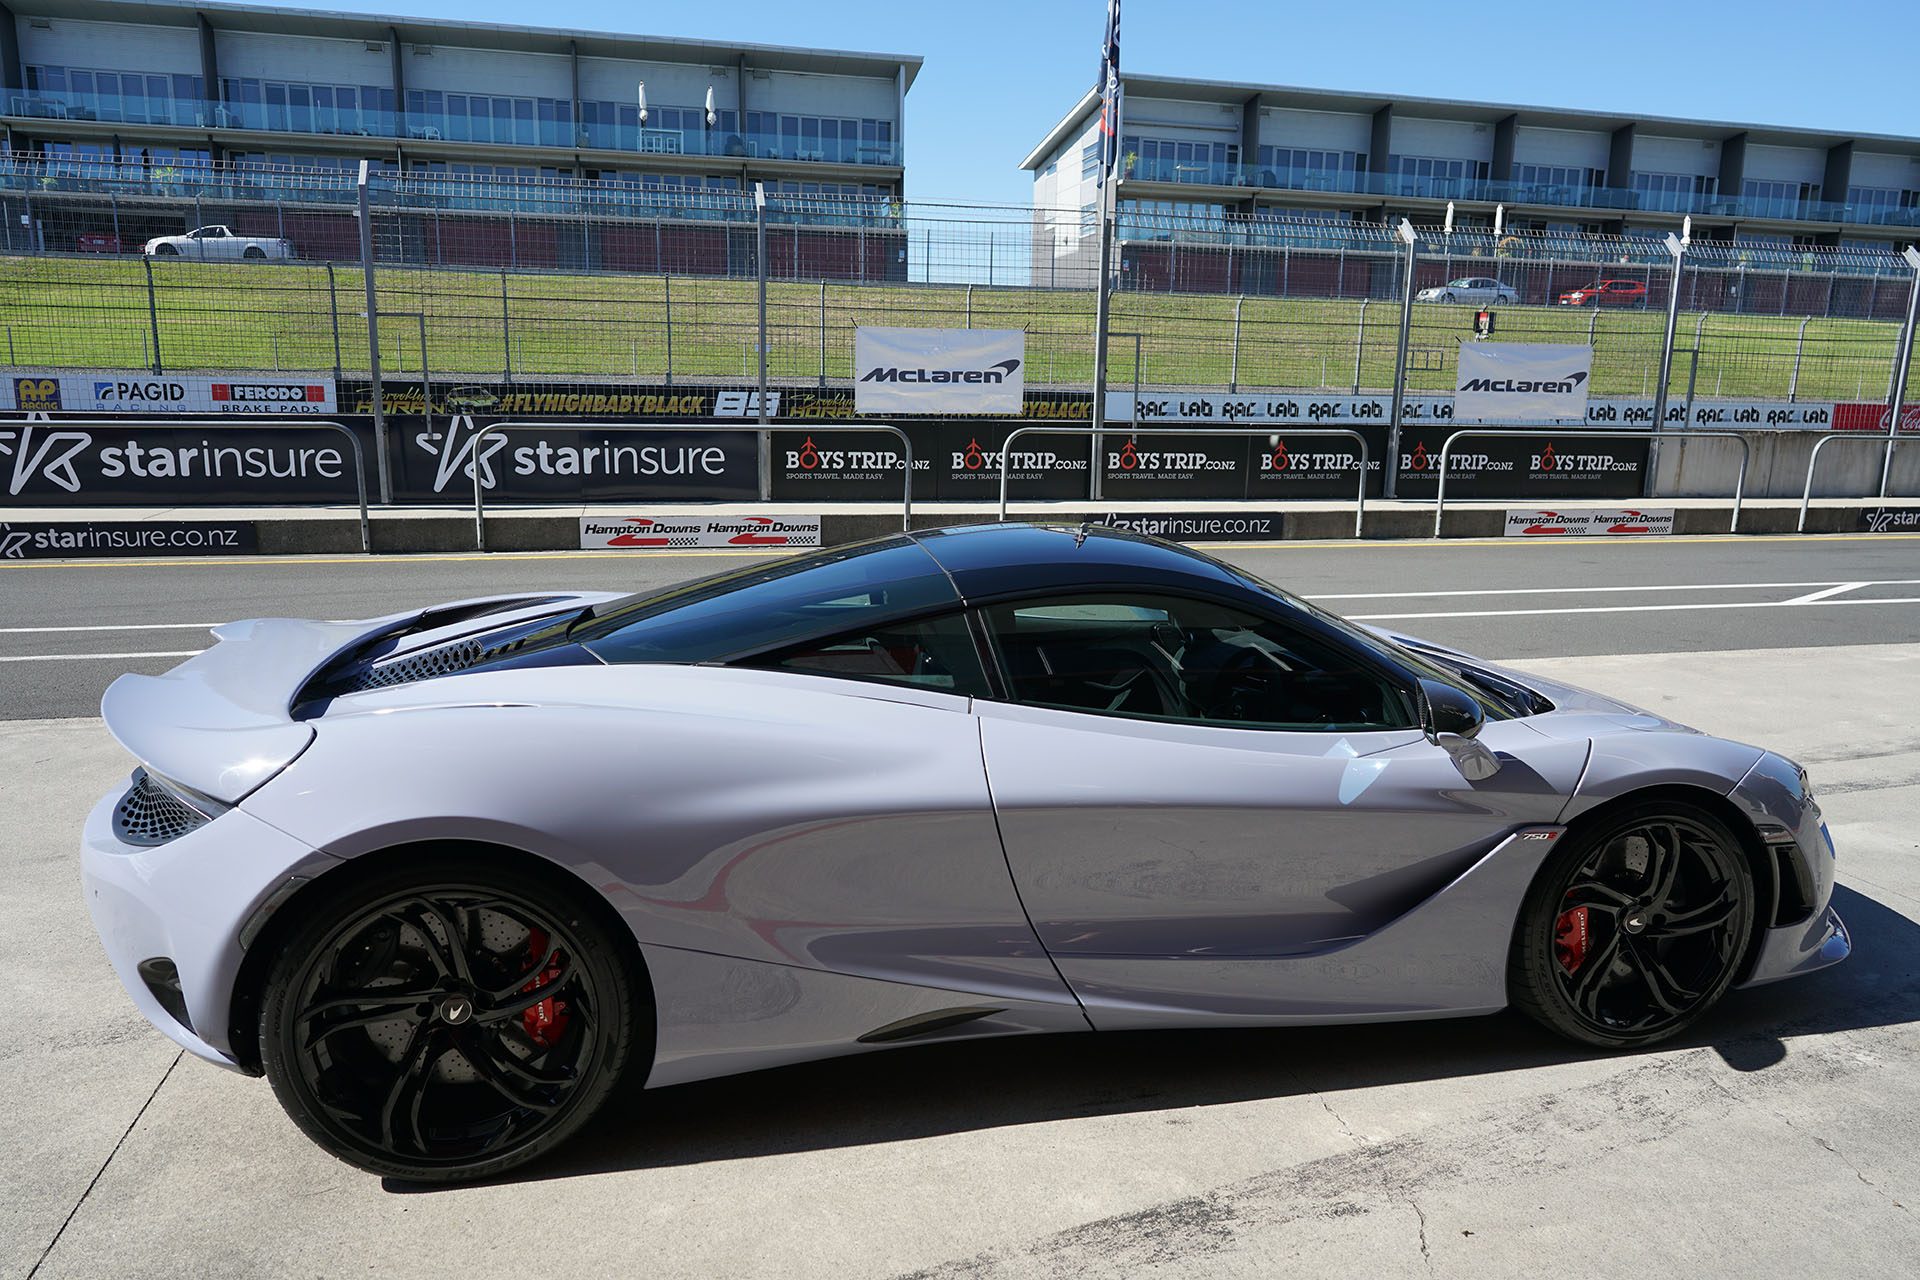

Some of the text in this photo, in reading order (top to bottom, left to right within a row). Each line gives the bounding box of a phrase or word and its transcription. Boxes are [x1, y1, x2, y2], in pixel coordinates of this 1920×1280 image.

[860, 367, 1003, 383] McLaren
[19, 380, 56, 400] AP
[118, 382, 185, 400] PAGID
[234, 386, 304, 400] FERODO
[1460, 378, 1573, 393] McLaren
[96, 403, 187, 411] RACING
[222, 405, 320, 414] BRAKE PADS
[501, 393, 705, 414] #FLYHIGHBABYBLACK
[1402, 401, 1455, 418] AC LA
[100, 440, 343, 478] starinsure
[513, 440, 726, 476] starinsure
[786, 450, 845, 470] BOYS
[1108, 452, 1160, 470] BOYS
[1261, 453, 1309, 470] BOYS
[1530, 454, 1574, 471] BOYS
[1132, 517, 1271, 535] starinsure.co.nz
[1508, 515, 1590, 526] Hampton Downs
[1593, 514, 1672, 525] Hampton Downs
[585, 523, 701, 537] Hampton Downs
[706, 522, 819, 535] Hampton Downs
[35, 526, 239, 549] starinsure.co.nz
